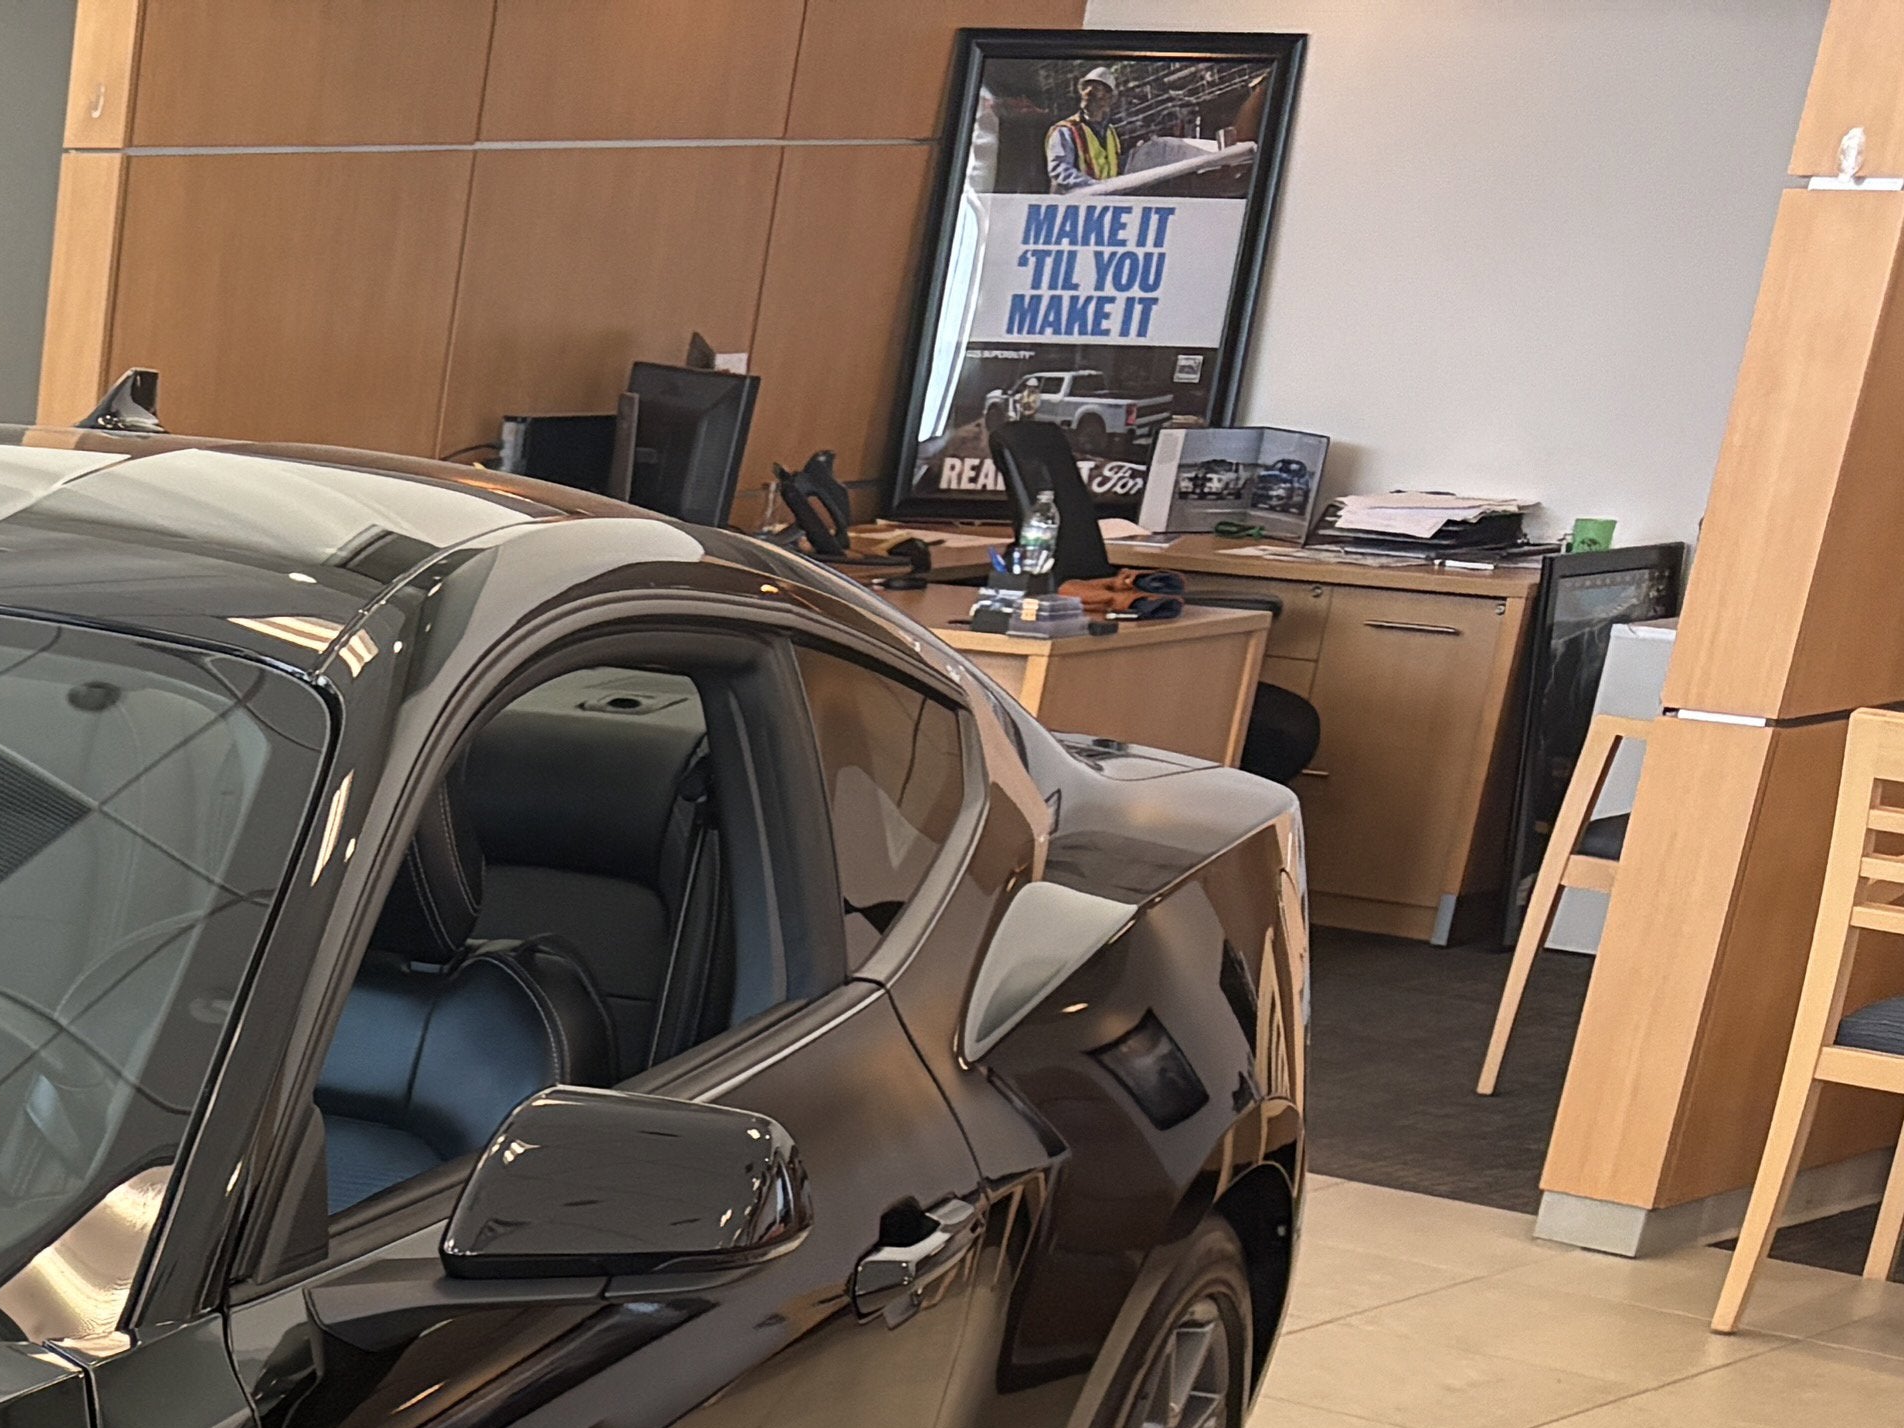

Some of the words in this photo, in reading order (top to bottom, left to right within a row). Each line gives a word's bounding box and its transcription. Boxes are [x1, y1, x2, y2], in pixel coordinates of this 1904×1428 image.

[1021, 203, 1133, 247] MAKE
[1136, 206, 1176, 248] IT
[1092, 250, 1167, 293] YOU
[1005, 293, 1117, 336] MAKE
[1119, 296, 1159, 338] IT
[1092, 461, 1147, 495] For
